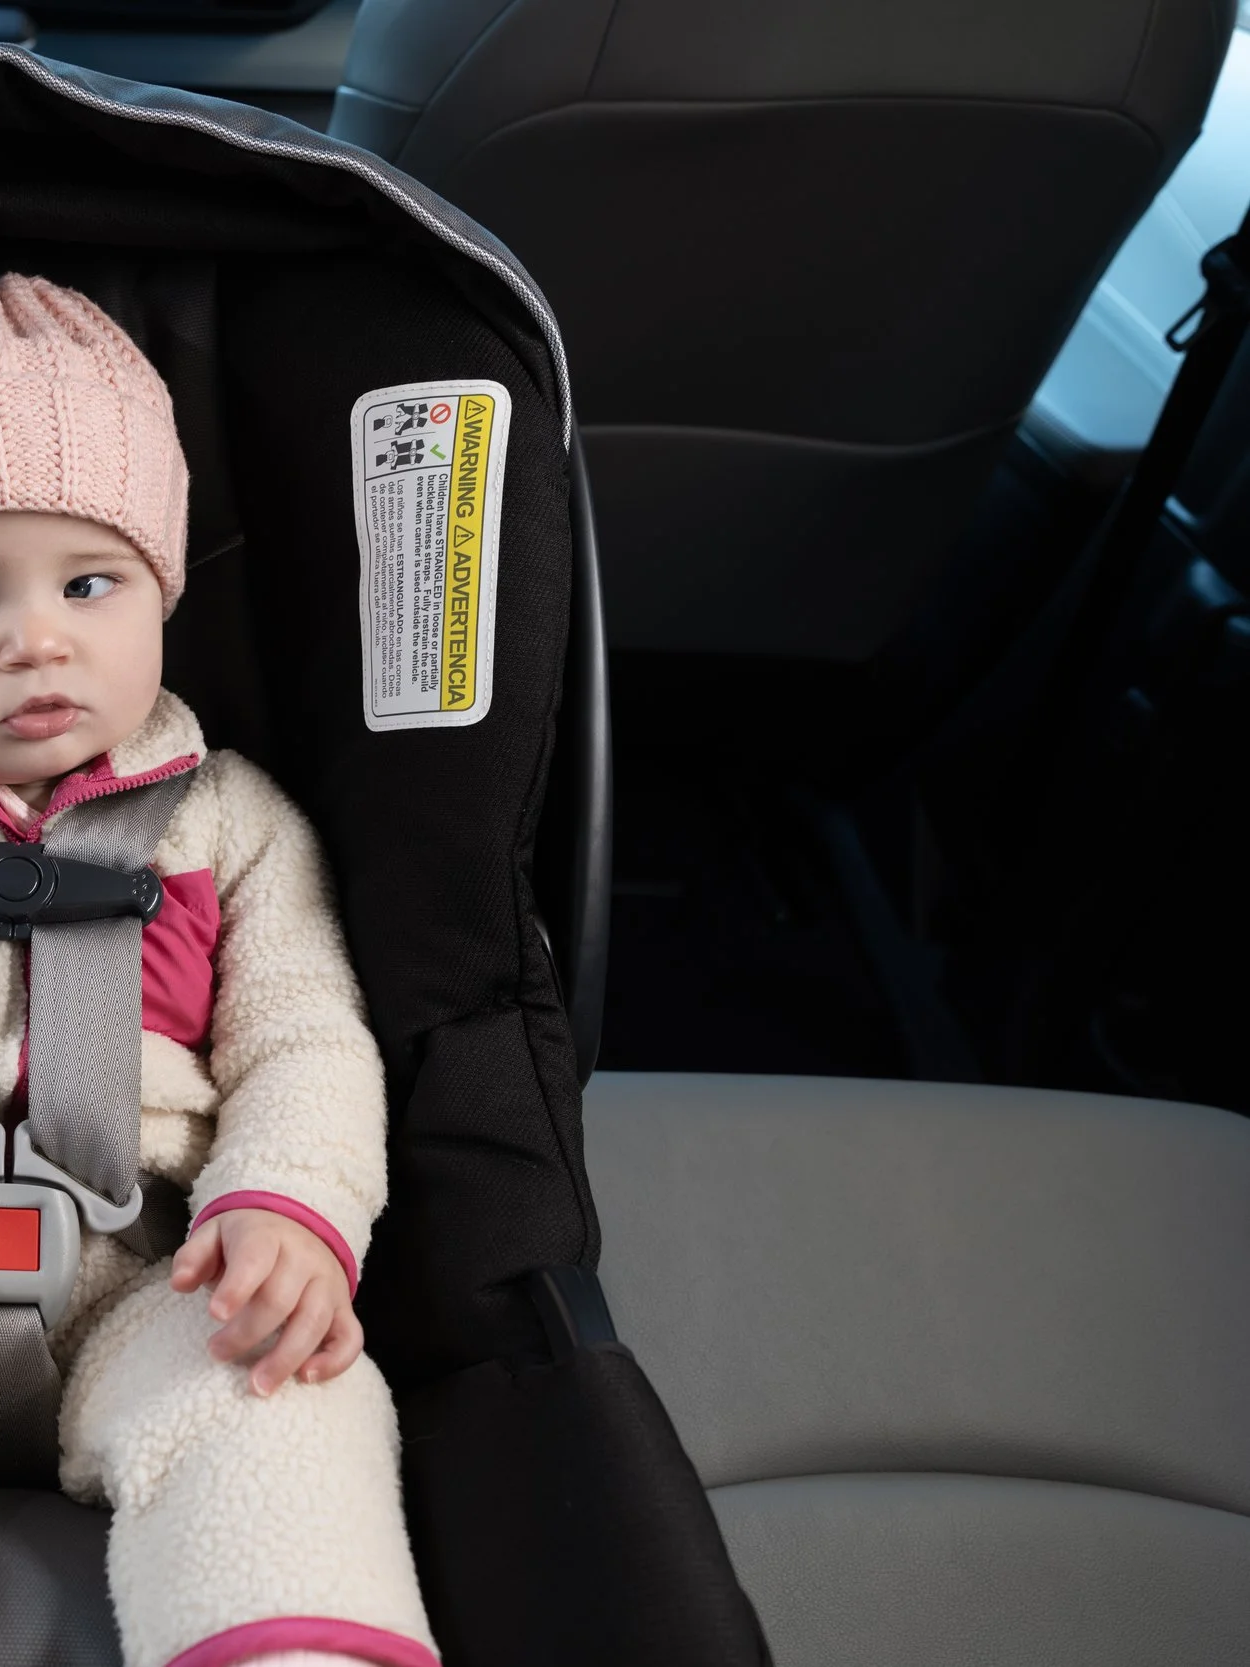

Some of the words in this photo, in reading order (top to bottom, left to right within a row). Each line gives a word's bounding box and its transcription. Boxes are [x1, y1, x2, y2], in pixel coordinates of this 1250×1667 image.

[456, 418, 483, 518] WARNING
[380, 484, 386, 494] de
[427, 475, 437, 510] buckled
[437, 474, 448, 511] Children
[371, 496, 379, 530] portador
[375, 533, 380, 543] se
[416, 500, 424, 524] when
[436, 514, 445, 536] have
[397, 523, 403, 533] se
[415, 528, 423, 557] carrier
[425, 513, 434, 549] harness
[423, 553, 432, 584] straps.
[434, 539, 444, 598] STRANGLED
[421, 589, 431, 611] Fully
[433, 602, 441, 610] in
[432, 613, 441, 638] loose
[448, 551, 471, 705] ADVERTENCIA
[396, 637, 401, 647] en
[432, 641, 438, 650] or
[429, 654, 438, 690] partially
